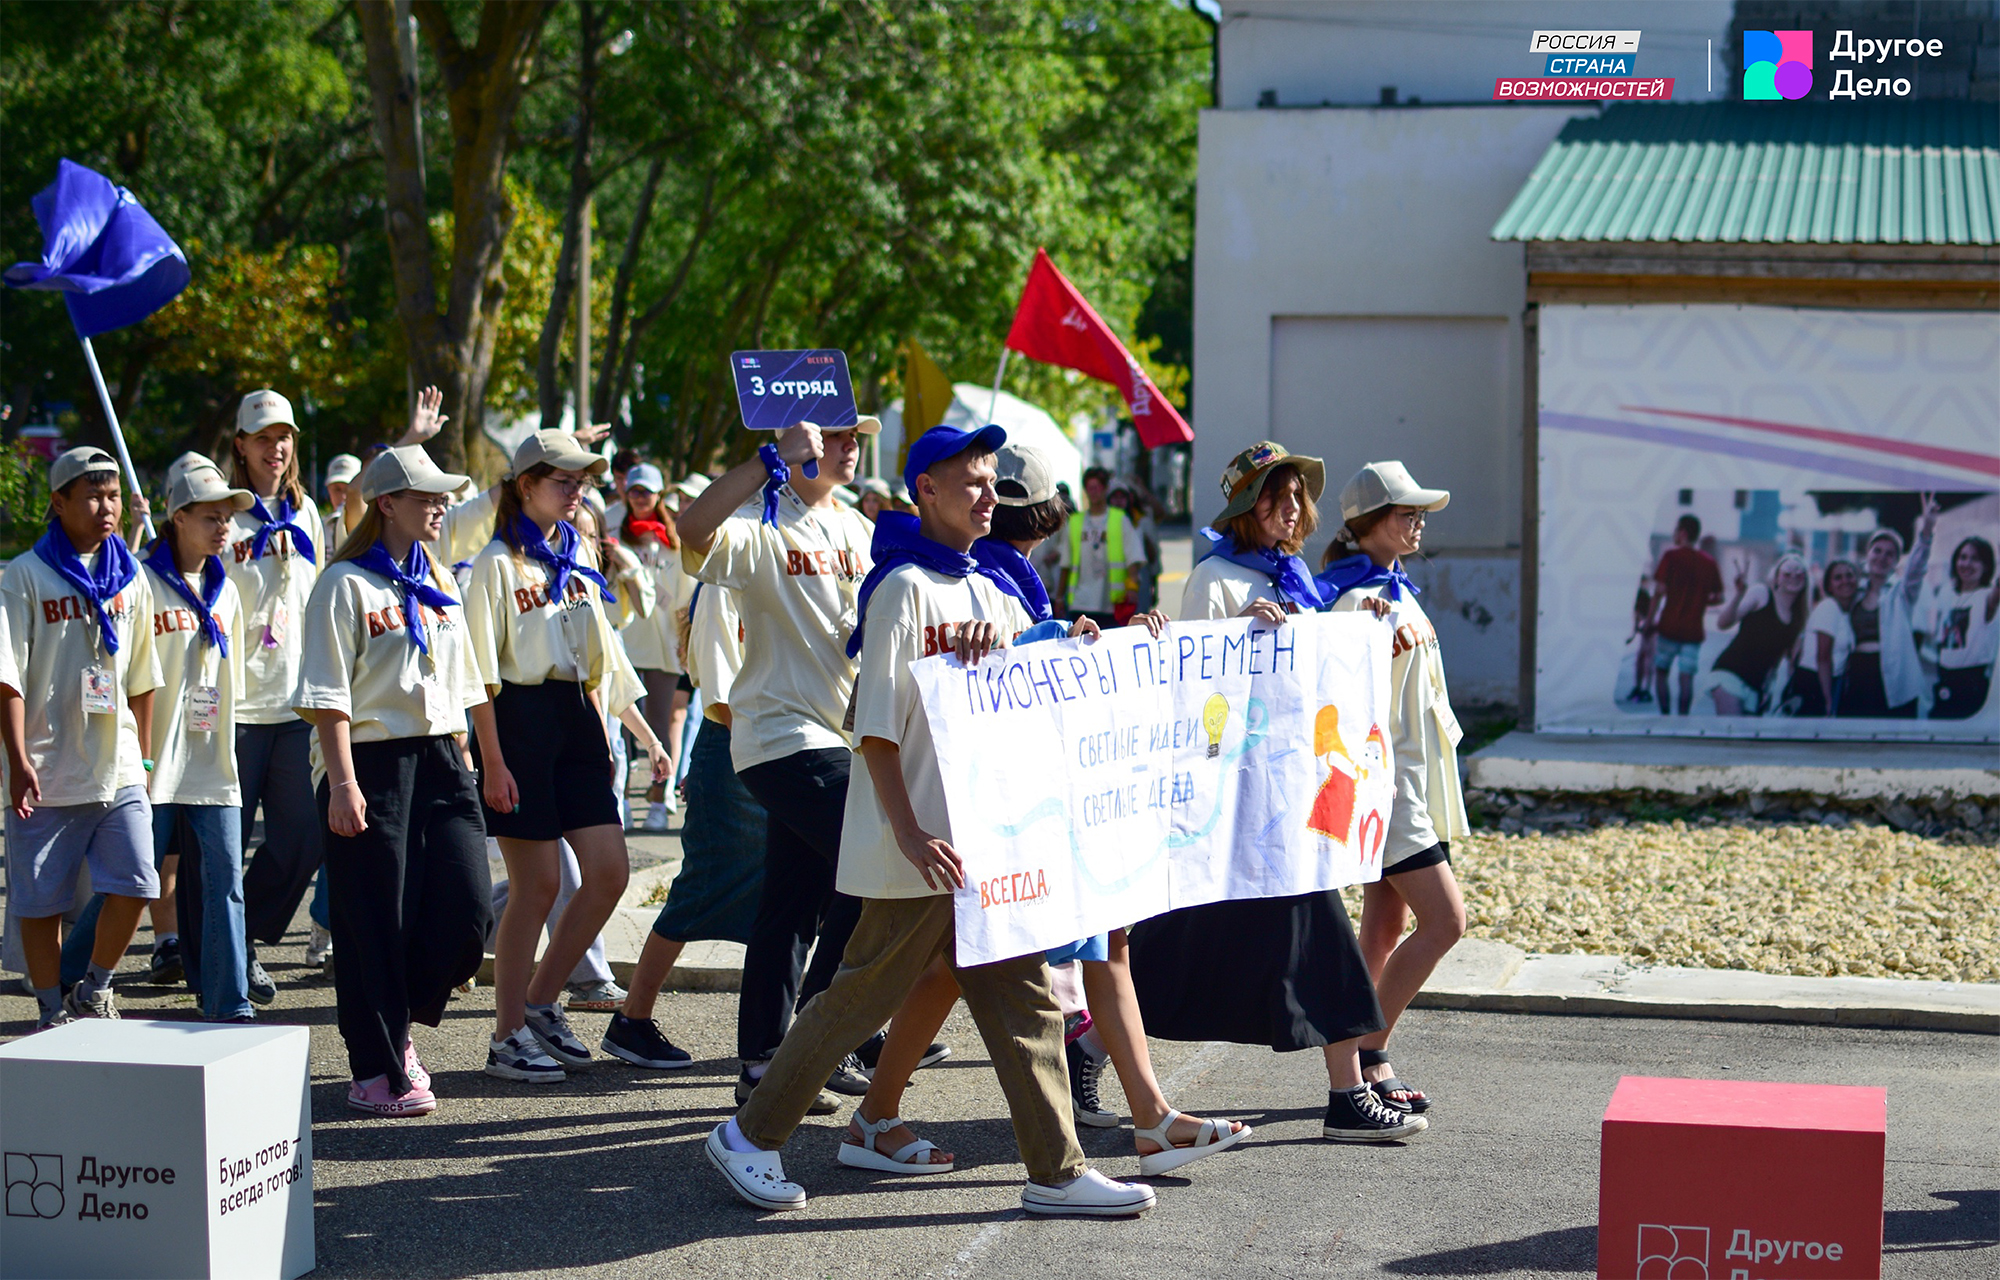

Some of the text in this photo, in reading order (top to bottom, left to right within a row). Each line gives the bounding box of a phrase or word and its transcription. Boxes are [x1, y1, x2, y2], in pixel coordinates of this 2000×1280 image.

[750, 375, 839, 400] 3 отряд
[786, 548, 865, 577] ВСЕДА
[966, 627, 1296, 715] ПИОНЕРЫ ПЕРЕМЕН
[1149, 717, 1199, 752] ИДЕИ
[1083, 783, 1138, 827] СВЕТЛЫЕ
[980, 868, 1048, 909] ВСЕГДА
[373, 1103, 404, 1112] crocs
[77, 1155, 176, 1188] Другое
[219, 1157, 252, 1187] Будь
[255, 1139, 289, 1169] готов
[219, 1153, 303, 1216] всегда готов!
[78, 1192, 149, 1221] Дело
[1725, 1228, 1844, 1265] Другое
